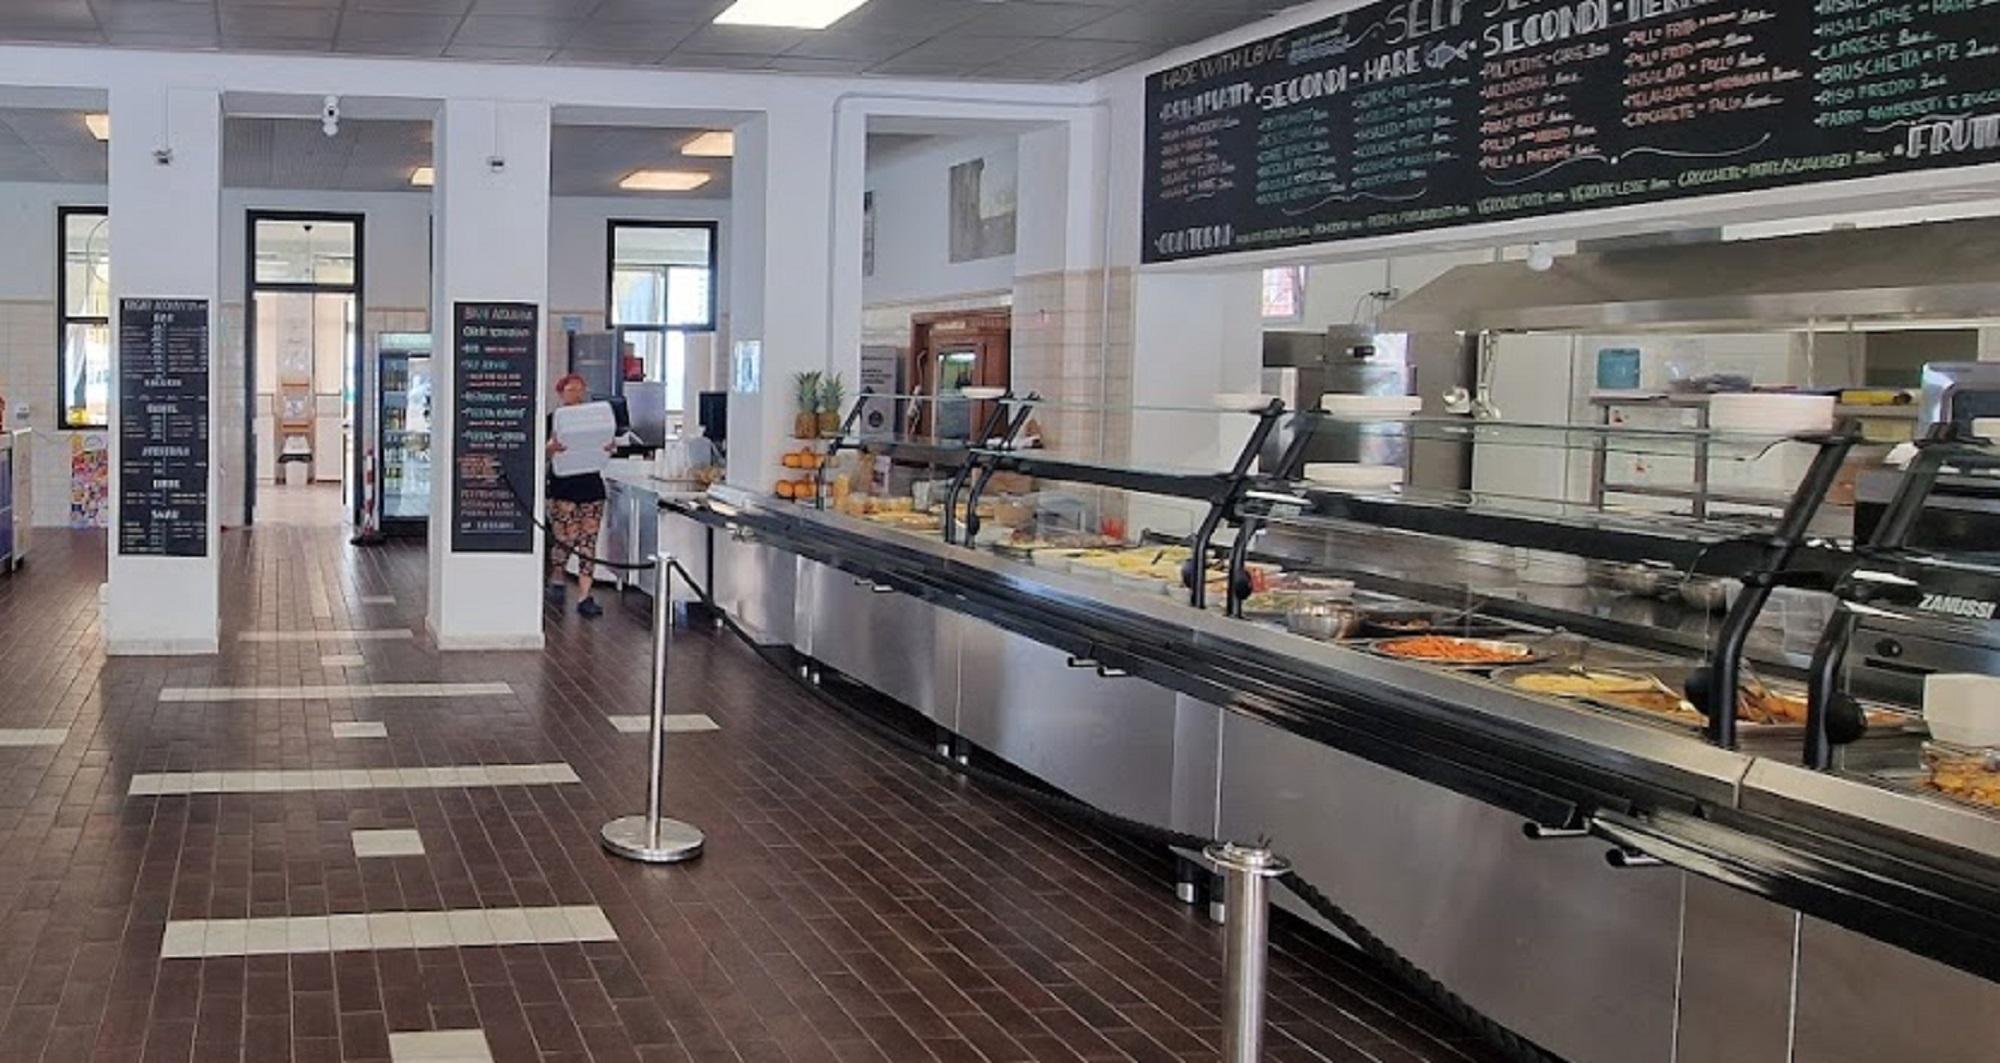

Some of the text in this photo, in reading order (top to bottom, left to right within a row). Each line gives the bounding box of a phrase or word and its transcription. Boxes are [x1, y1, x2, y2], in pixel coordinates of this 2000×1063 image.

[1483, 0, 1609, 58] SECONDI
[1818, 33, 1892, 62] CAPRESE
[1201, 53, 1240, 79] WITH
[1244, 37, 1286, 69] LOVE
[1820, 49, 1922, 85] BRUSCHETTA
[1261, 45, 1422, 111] SECONDI MARE
[1919, 593, 1997, 619] ZANUSSI
